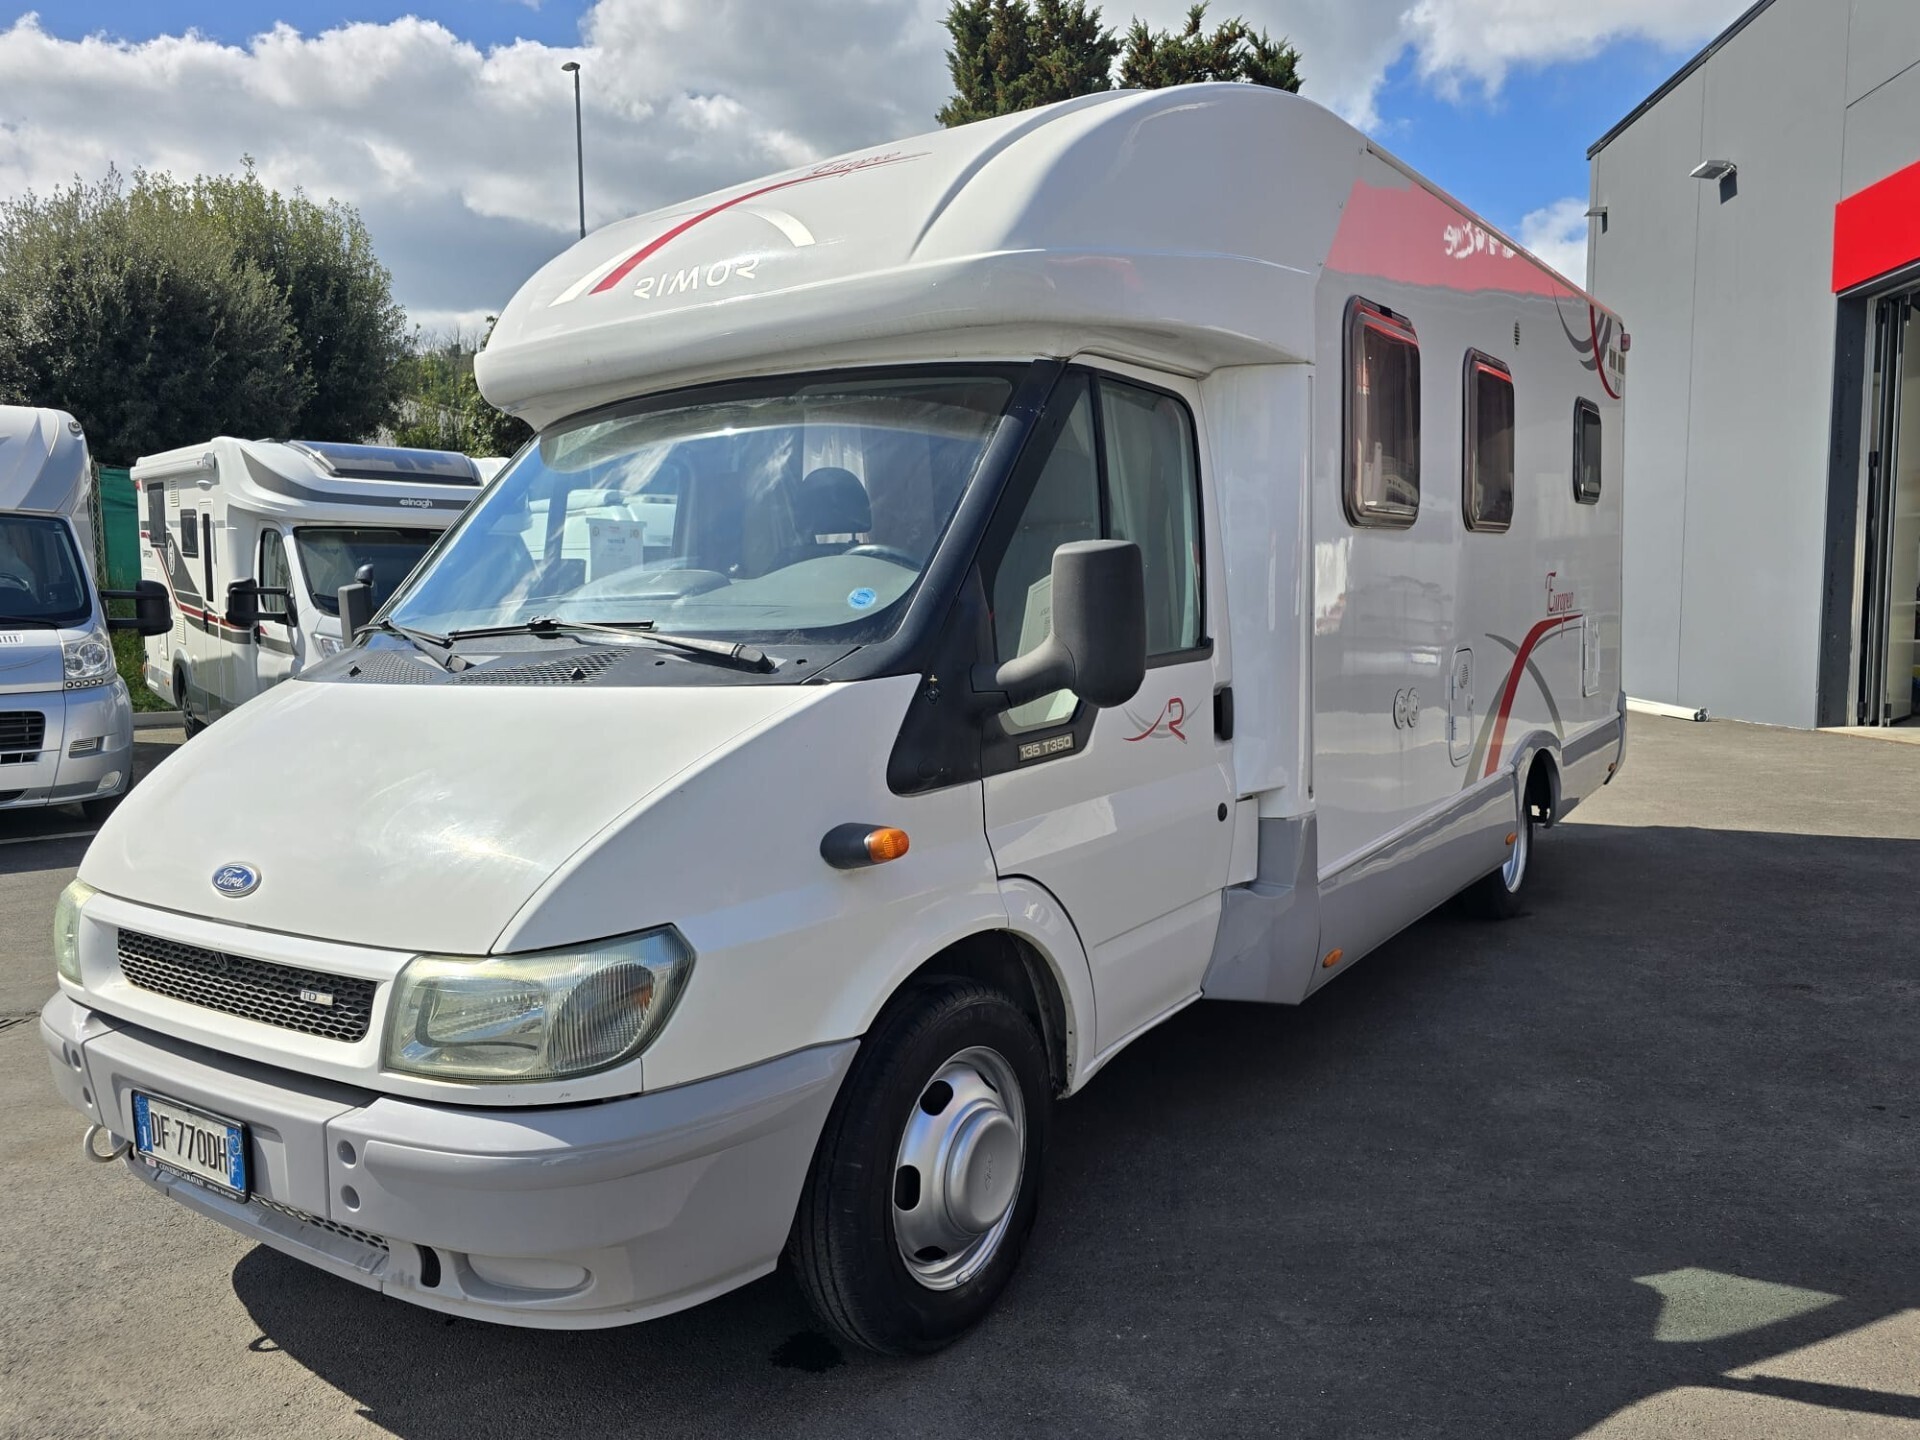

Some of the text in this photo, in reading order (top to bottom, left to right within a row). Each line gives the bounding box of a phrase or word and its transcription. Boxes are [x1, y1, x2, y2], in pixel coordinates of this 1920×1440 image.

[633, 256, 760, 300] RIMOR
[399, 498, 433, 509] elnagh
[1020, 735, 1072, 759] 135 T350
[217, 868, 248, 888] Ford
[150, 1110, 228, 1175] DF 770DH
